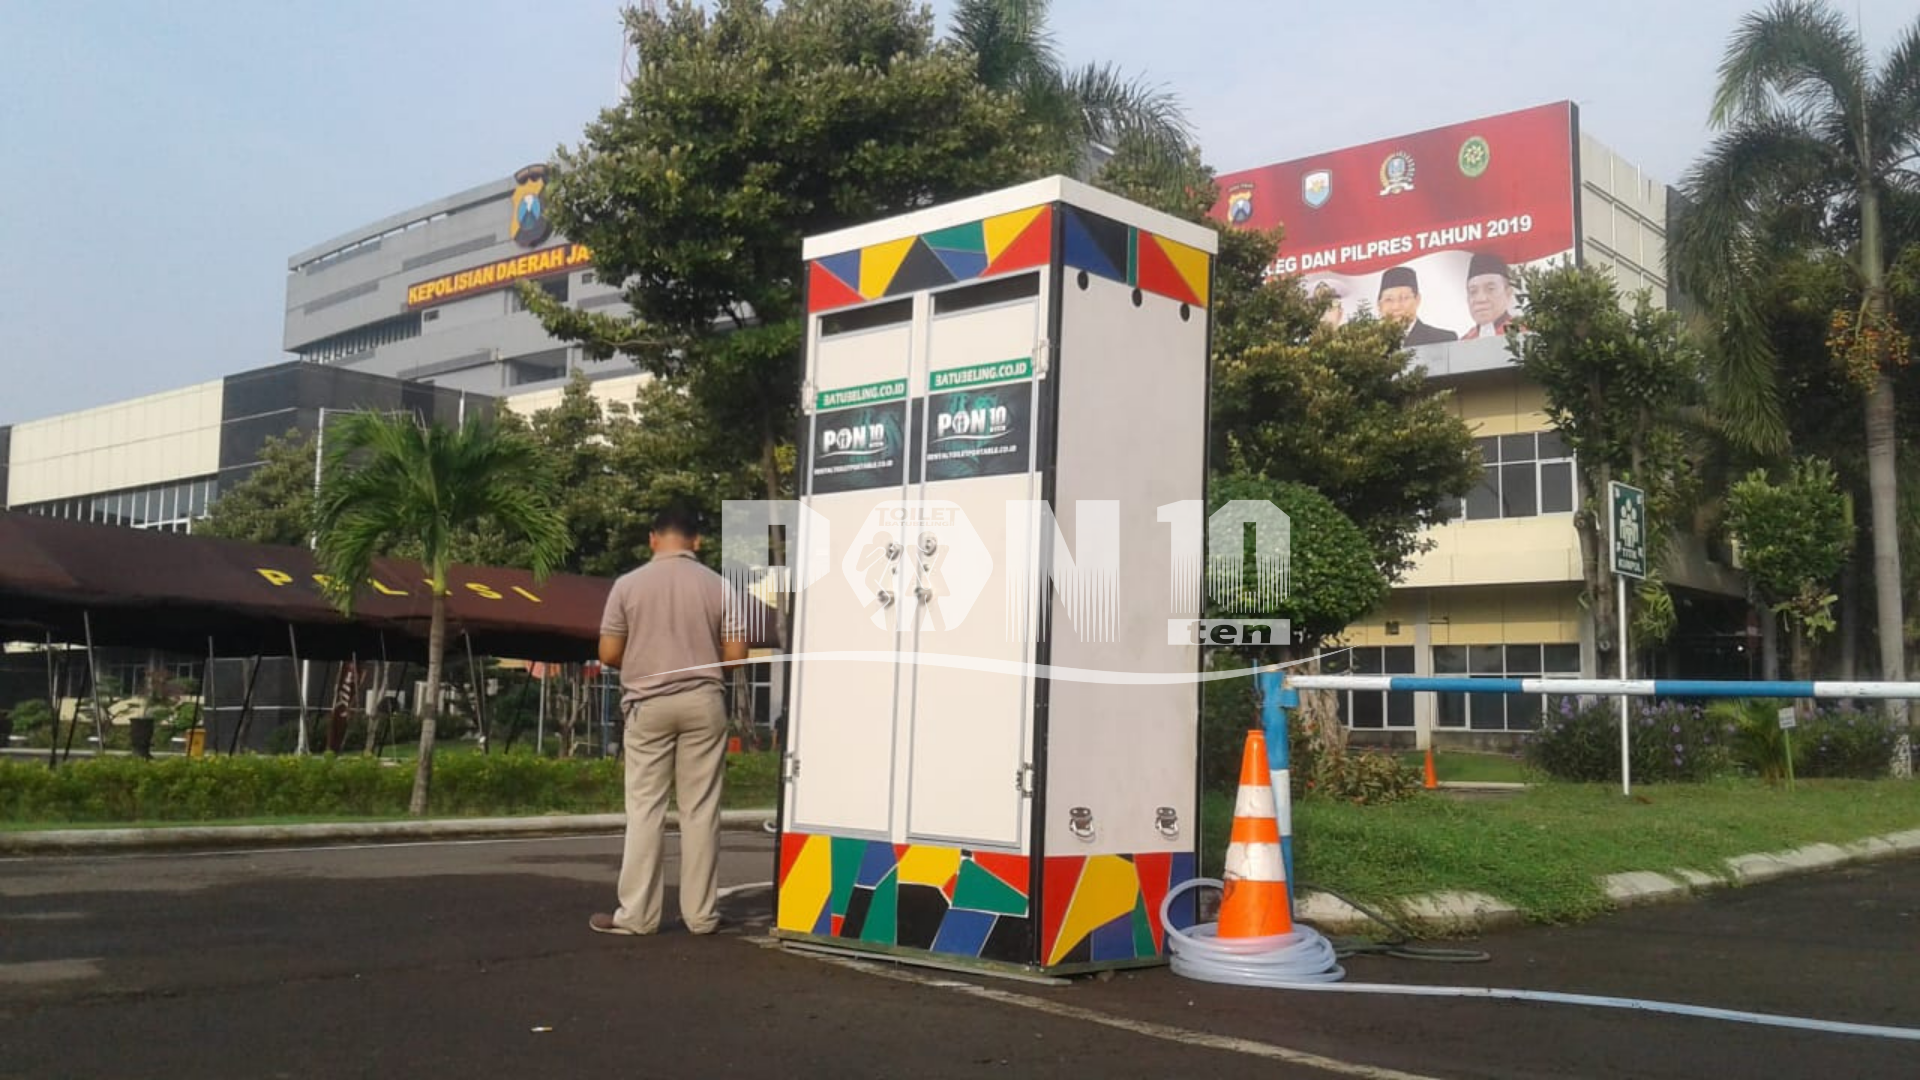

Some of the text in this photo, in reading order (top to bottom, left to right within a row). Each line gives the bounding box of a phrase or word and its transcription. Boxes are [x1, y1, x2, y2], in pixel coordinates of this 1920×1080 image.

[408, 244, 594, 305] KEPOLISIAN DAERAH JA
[1260, 214, 1532, 277] LEG DAN PILPRES TAHUN 2019
